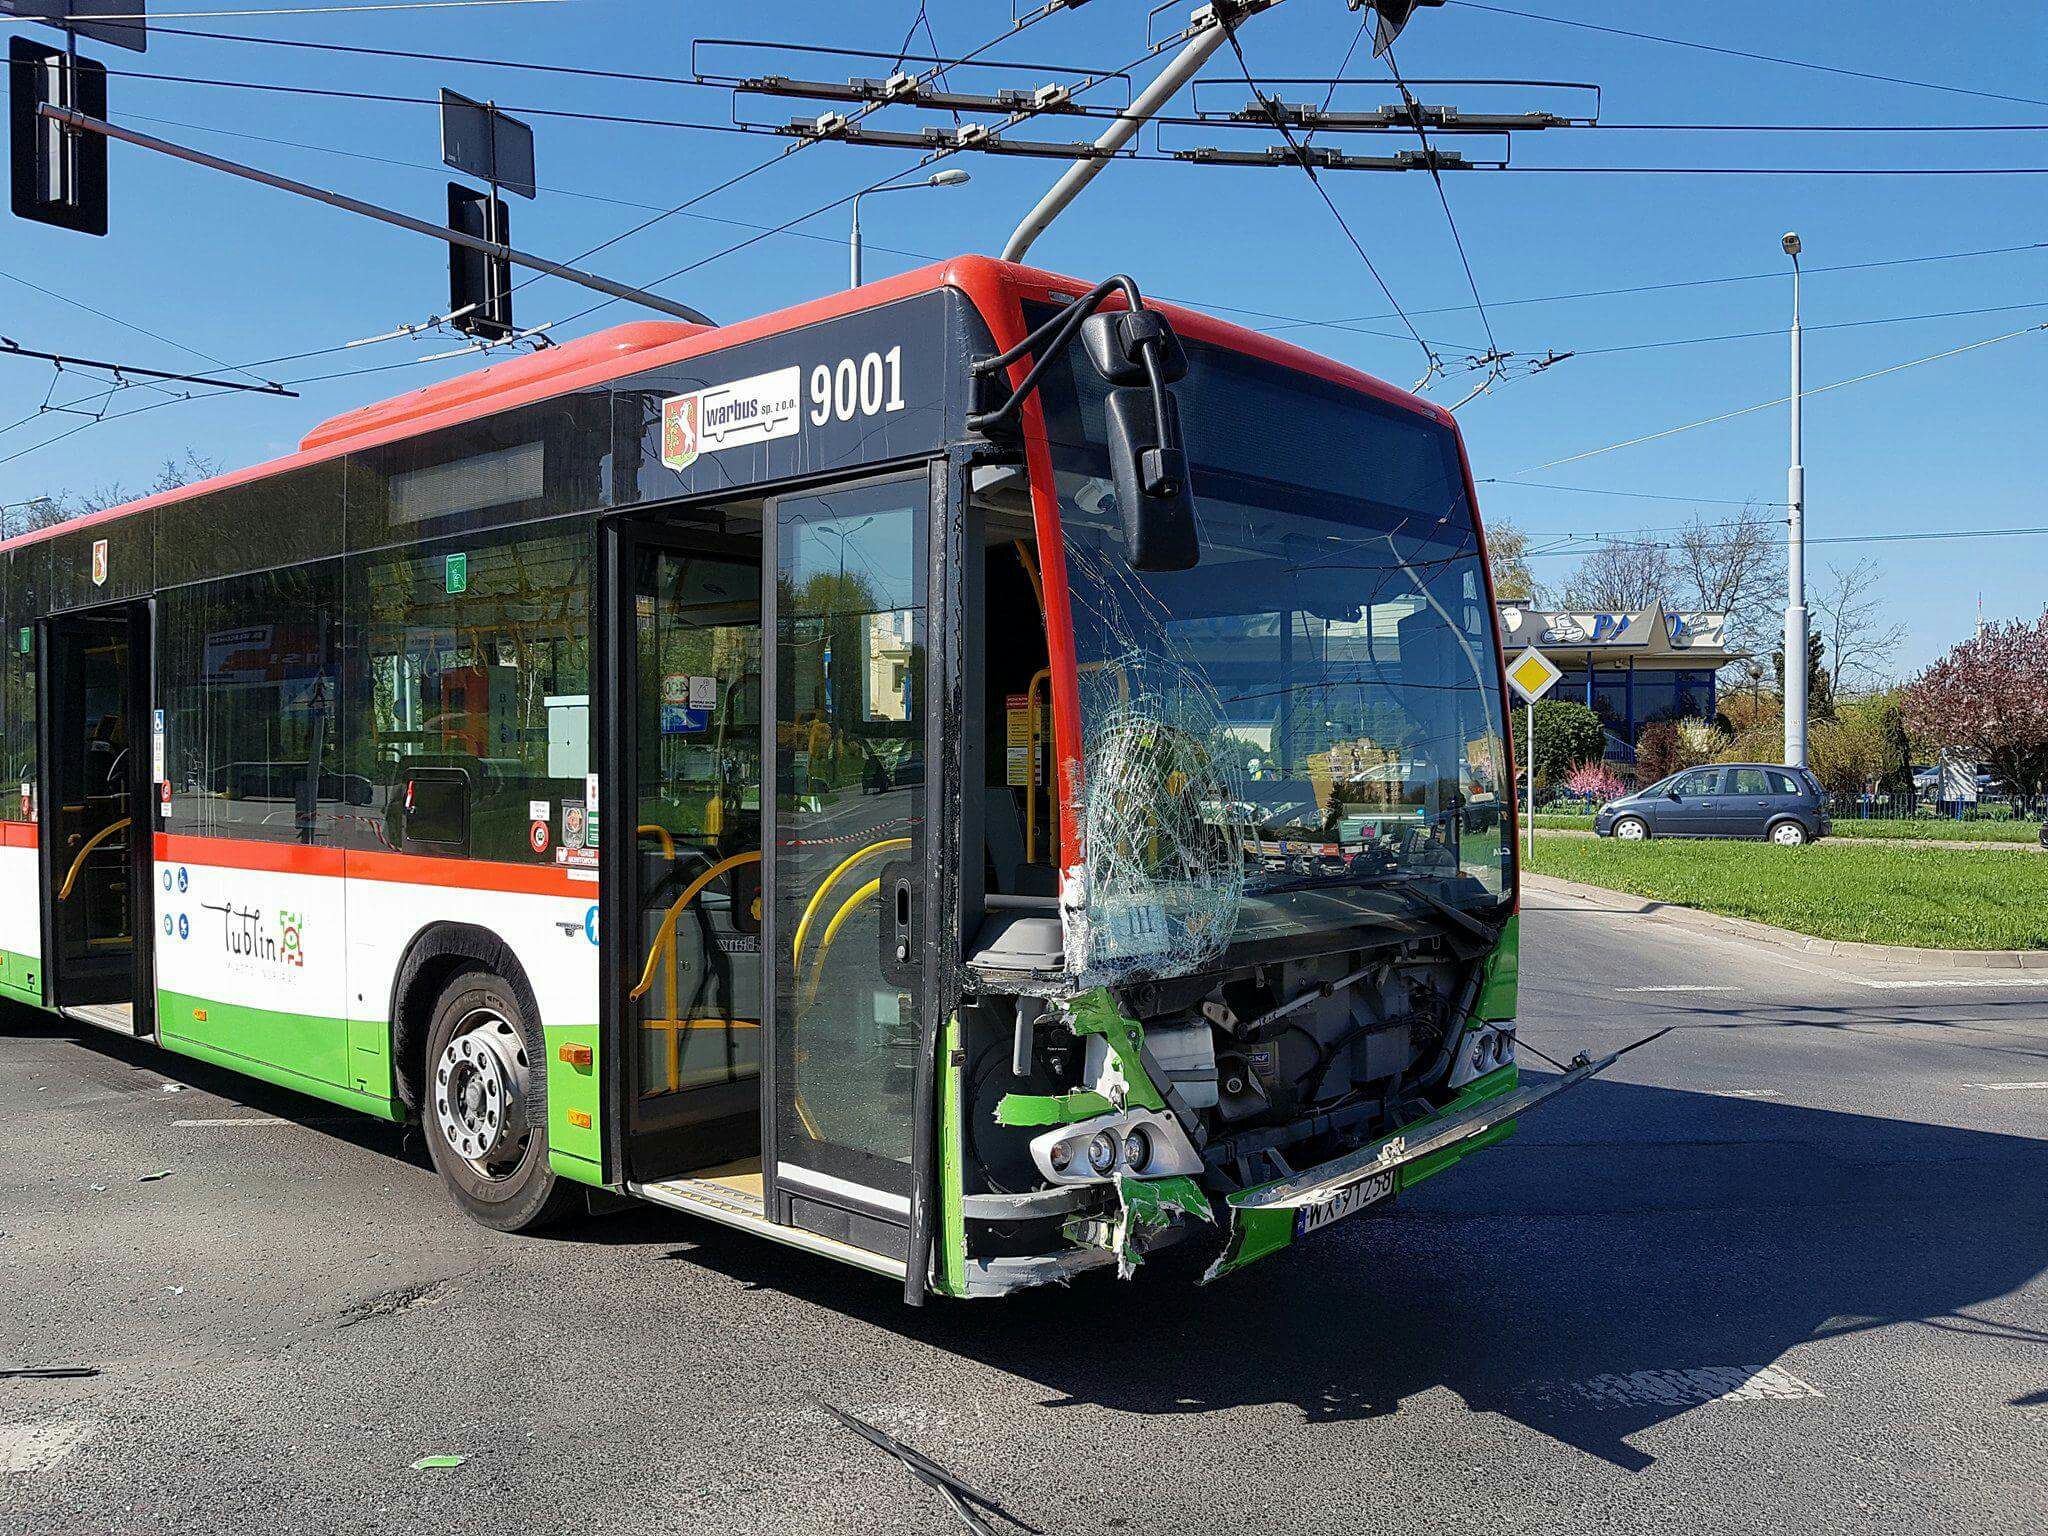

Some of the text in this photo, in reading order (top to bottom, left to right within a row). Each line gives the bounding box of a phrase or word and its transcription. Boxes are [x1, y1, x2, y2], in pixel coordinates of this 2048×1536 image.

[706, 398, 758, 428] warbus
[761, 404, 773, 416] sp.
[781, 398, 797, 411] o.o.
[810, 345, 905, 427] 9001
[1309, 1171, 1393, 1228] WX 91258
